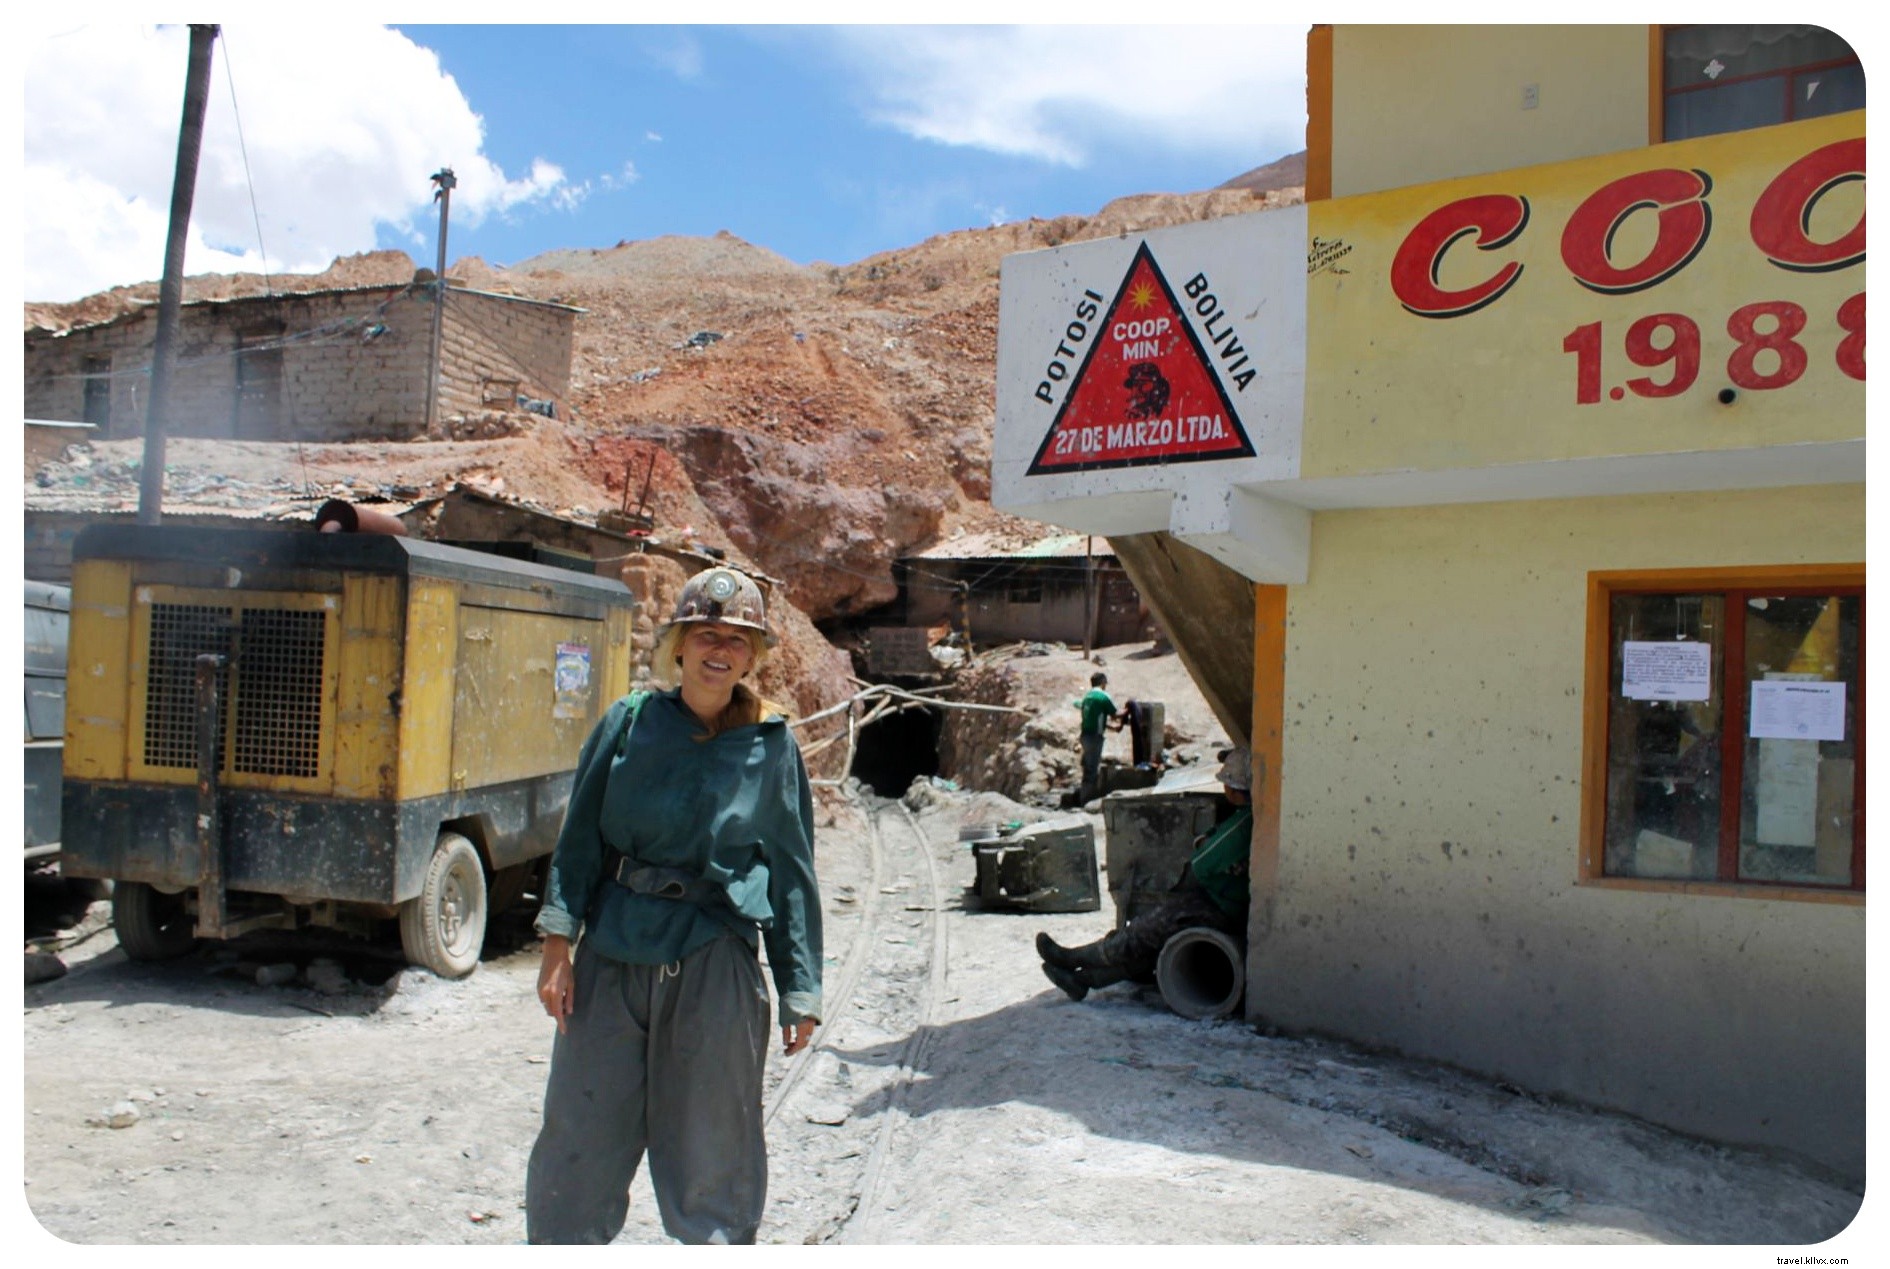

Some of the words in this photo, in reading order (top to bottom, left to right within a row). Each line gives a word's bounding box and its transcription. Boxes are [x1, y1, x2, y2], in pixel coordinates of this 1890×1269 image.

[1034, 288, 1104, 404] POTOSI
[1113, 318, 1173, 341] COOP.
[1184, 272, 1258, 392] BOLIVIA
[1122, 340, 1164, 361] MIN.
[1055, 429, 1075, 454] 27
[1081, 427, 1103, 452] DE
[1106, 419, 1173, 449] MARZO
[1177, 414, 1229, 443] LTDA.
